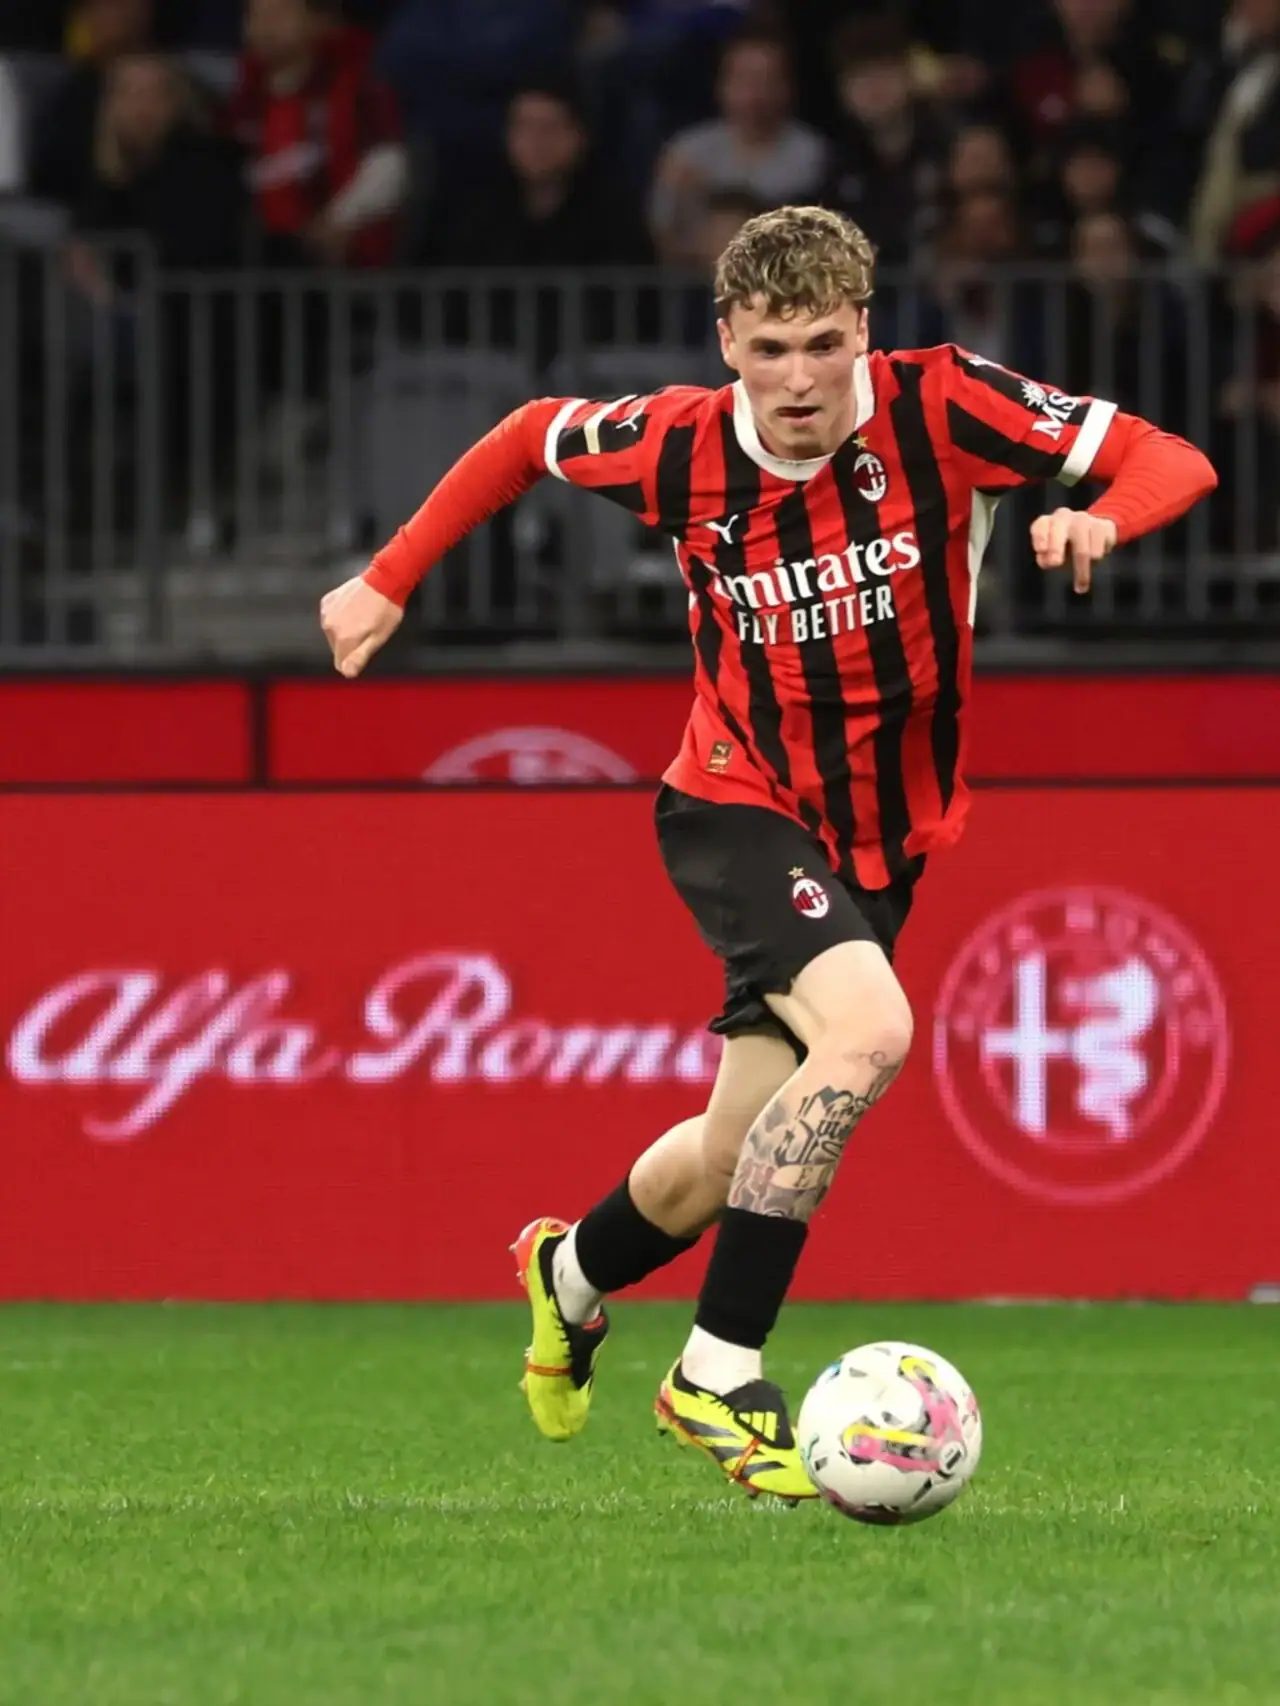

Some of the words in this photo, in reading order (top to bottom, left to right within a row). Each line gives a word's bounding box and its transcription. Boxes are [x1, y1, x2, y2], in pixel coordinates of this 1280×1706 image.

[737, 611, 778, 645] FLY
[791, 584, 895, 644] BETTER
[6, 968, 340, 1141] Alfa
